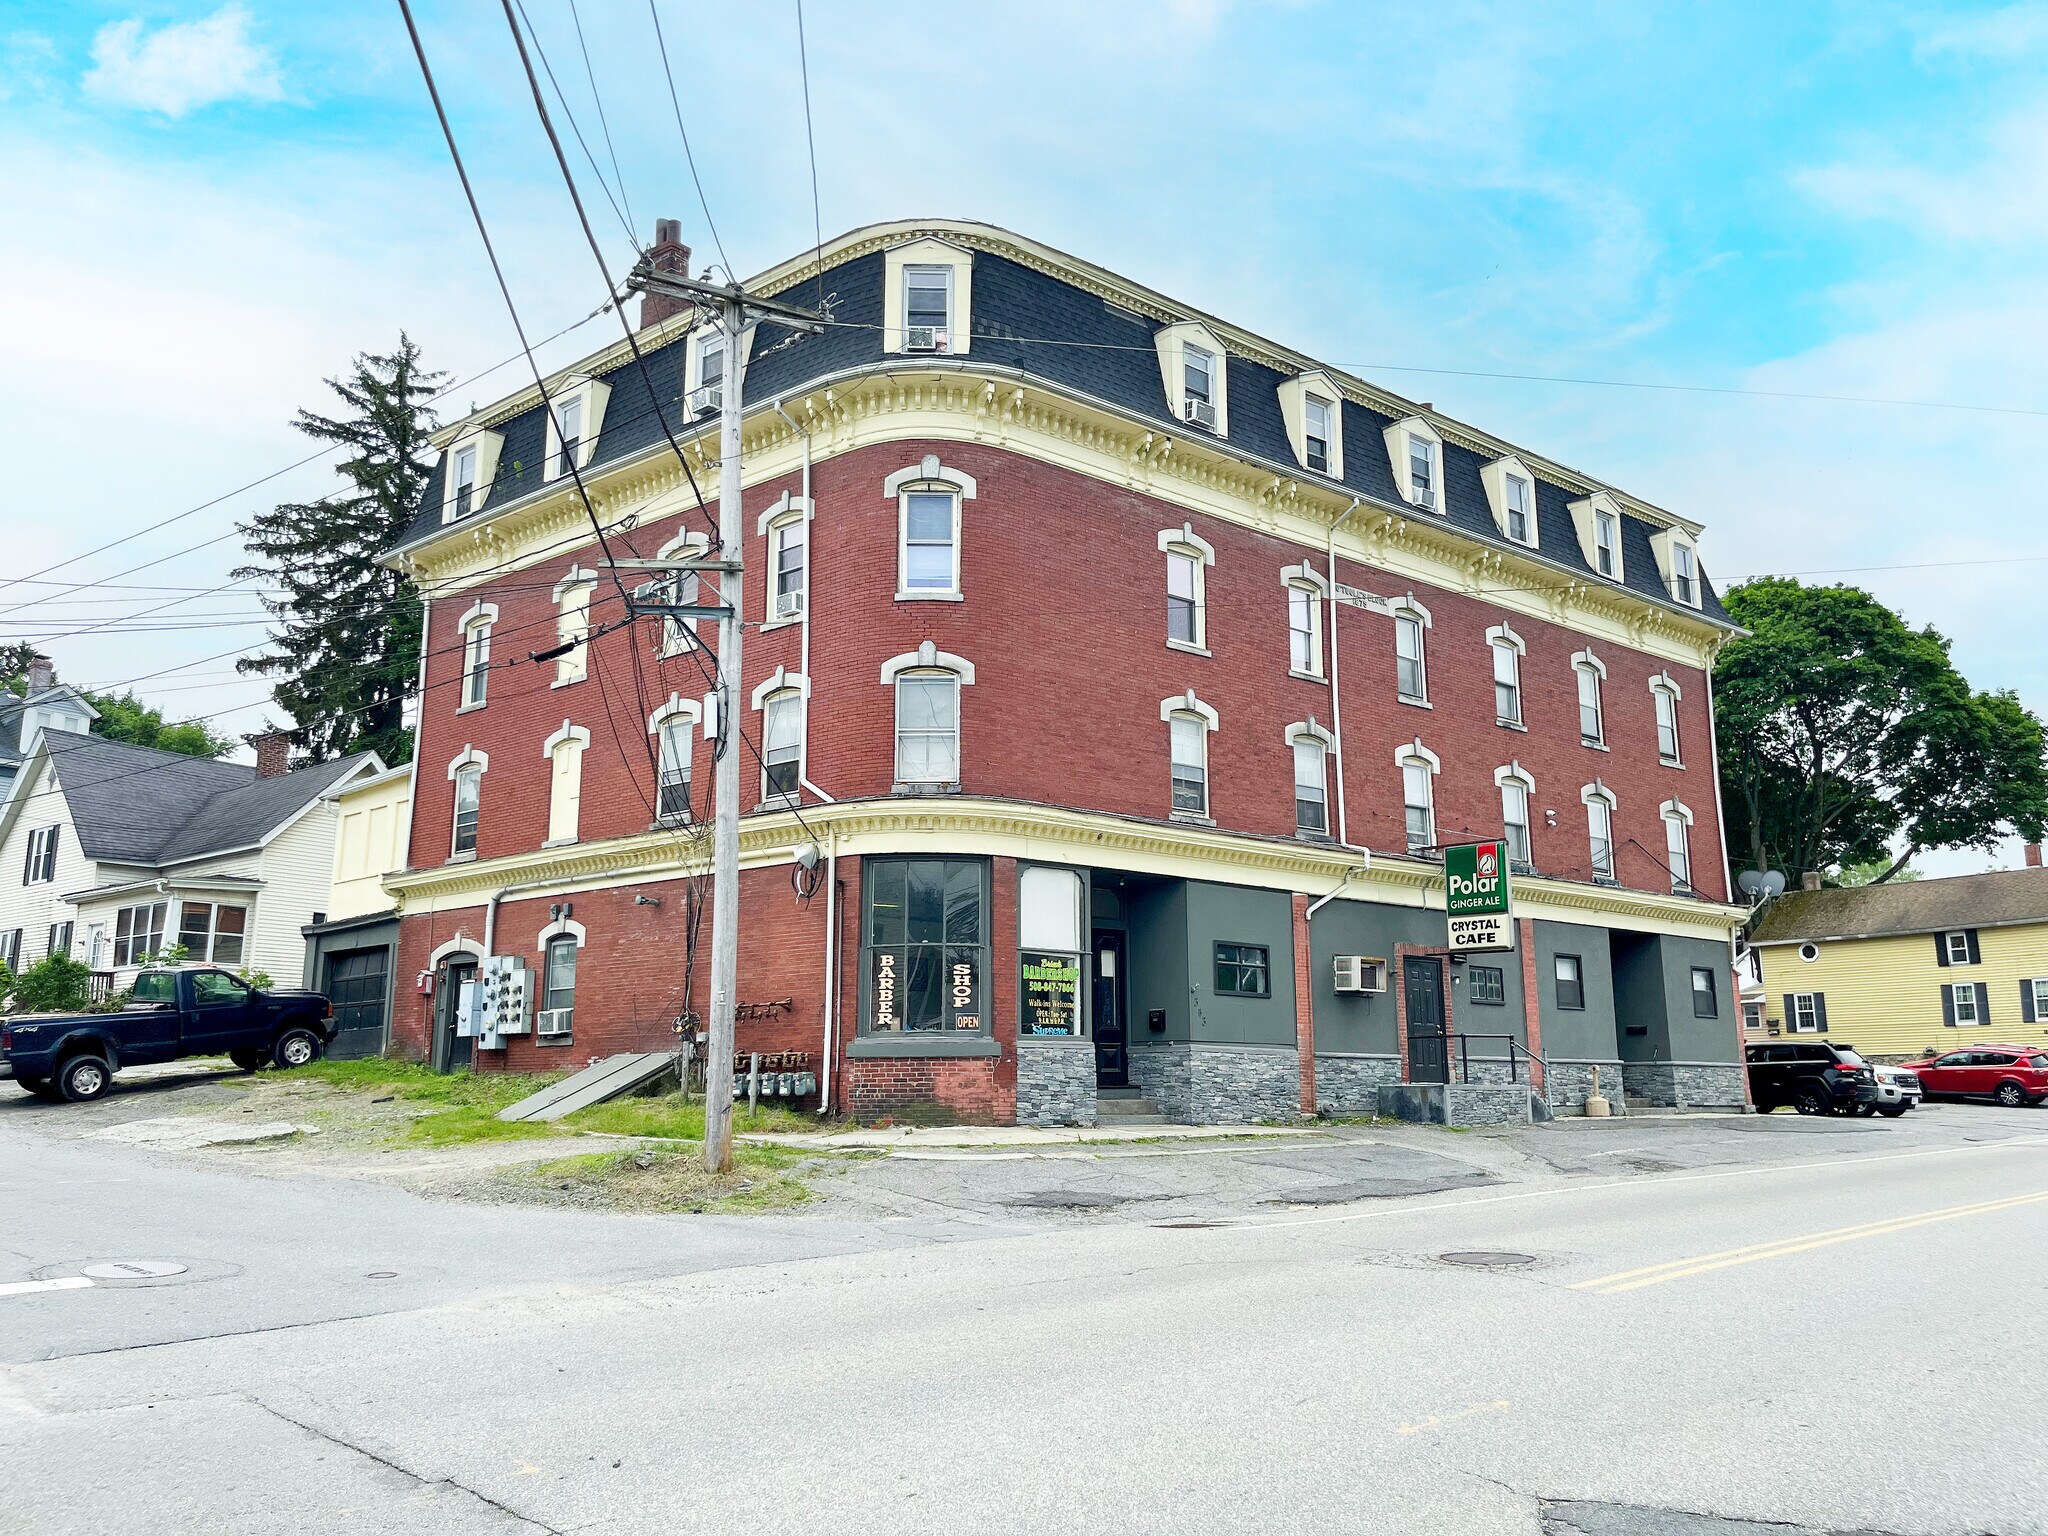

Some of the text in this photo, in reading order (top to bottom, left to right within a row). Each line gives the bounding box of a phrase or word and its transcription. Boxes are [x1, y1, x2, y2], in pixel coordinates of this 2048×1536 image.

[1449, 873, 1499, 896] Polar
[1450, 896, 1501, 909] GINGER ALE
[1451, 919, 1501, 932] CRYSTAL
[1455, 932, 1496, 945] CAFE
[1022, 964, 1079, 981] BARBERSHOP
[877, 955, 896, 1024] BARBER
[953, 964, 971, 1007] SHOP
[957, 1016, 979, 1028] OPEN
